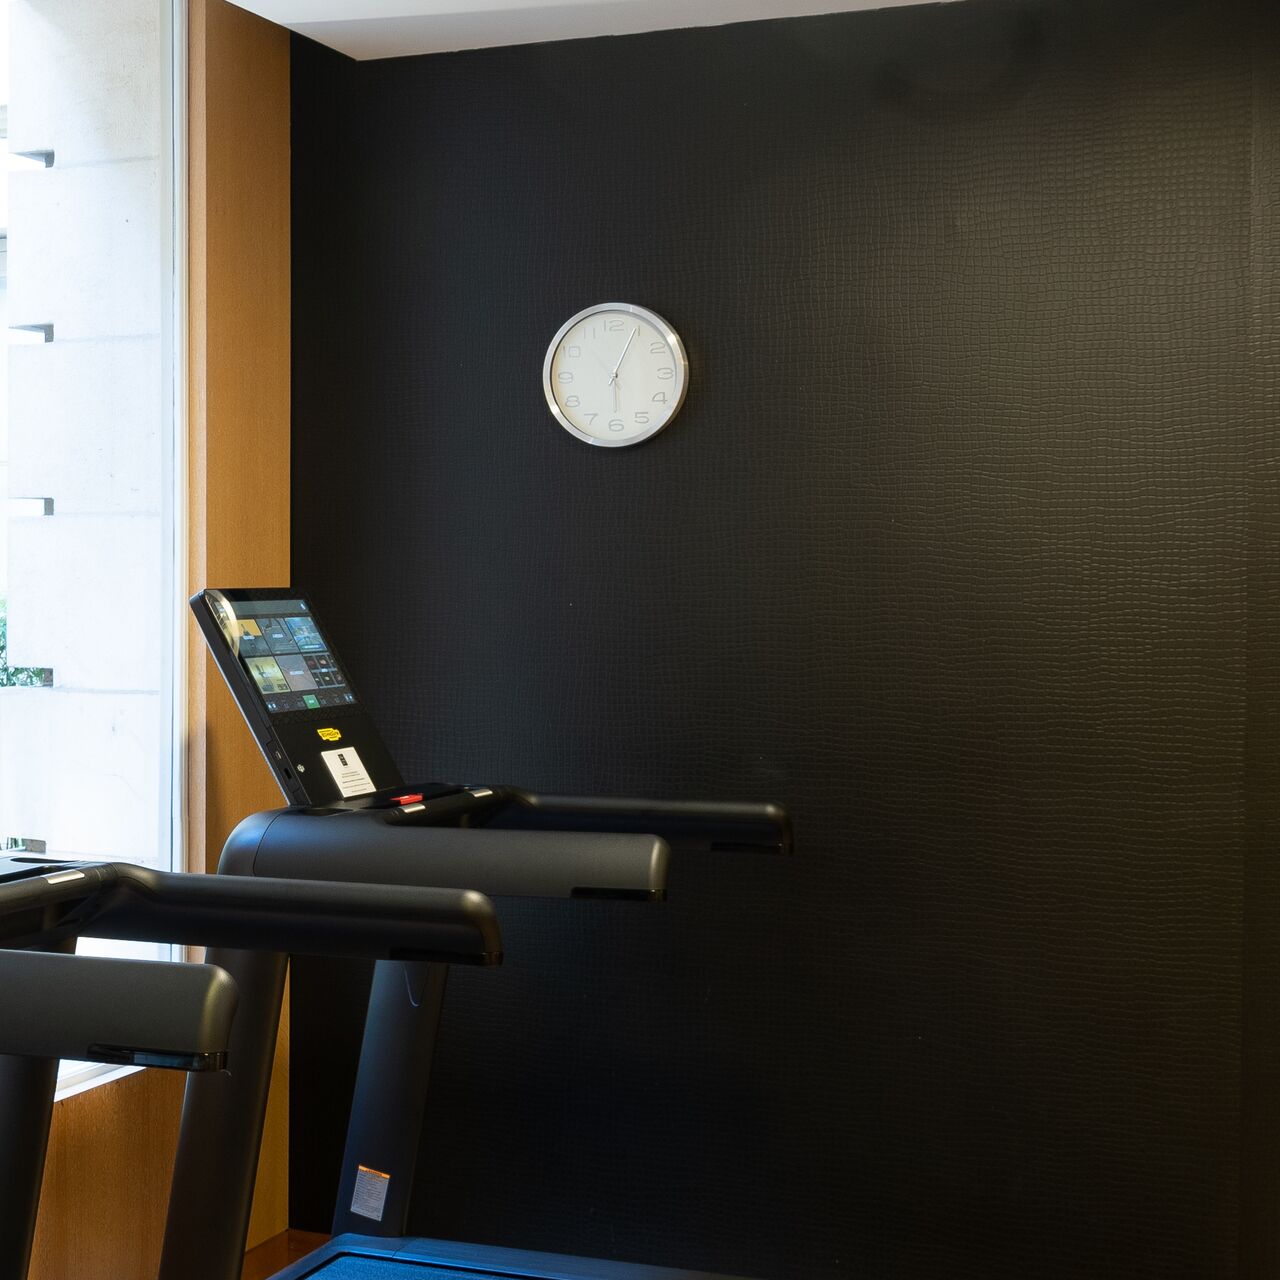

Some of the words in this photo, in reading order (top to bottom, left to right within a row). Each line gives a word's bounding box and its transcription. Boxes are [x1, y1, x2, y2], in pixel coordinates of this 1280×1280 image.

[604, 319, 625, 332] 12
[583, 327, 596, 339] 11
[562, 346, 581, 358] 10
[650, 342, 666, 354] 2
[558, 371, 574, 384] 9
[657, 367, 674, 380] 3
[565, 395, 580, 408] 8
[652, 392, 668, 404] 4
[584, 413, 599, 425] 7
[634, 412, 650, 424] 5
[608, 419, 625, 432] 6
